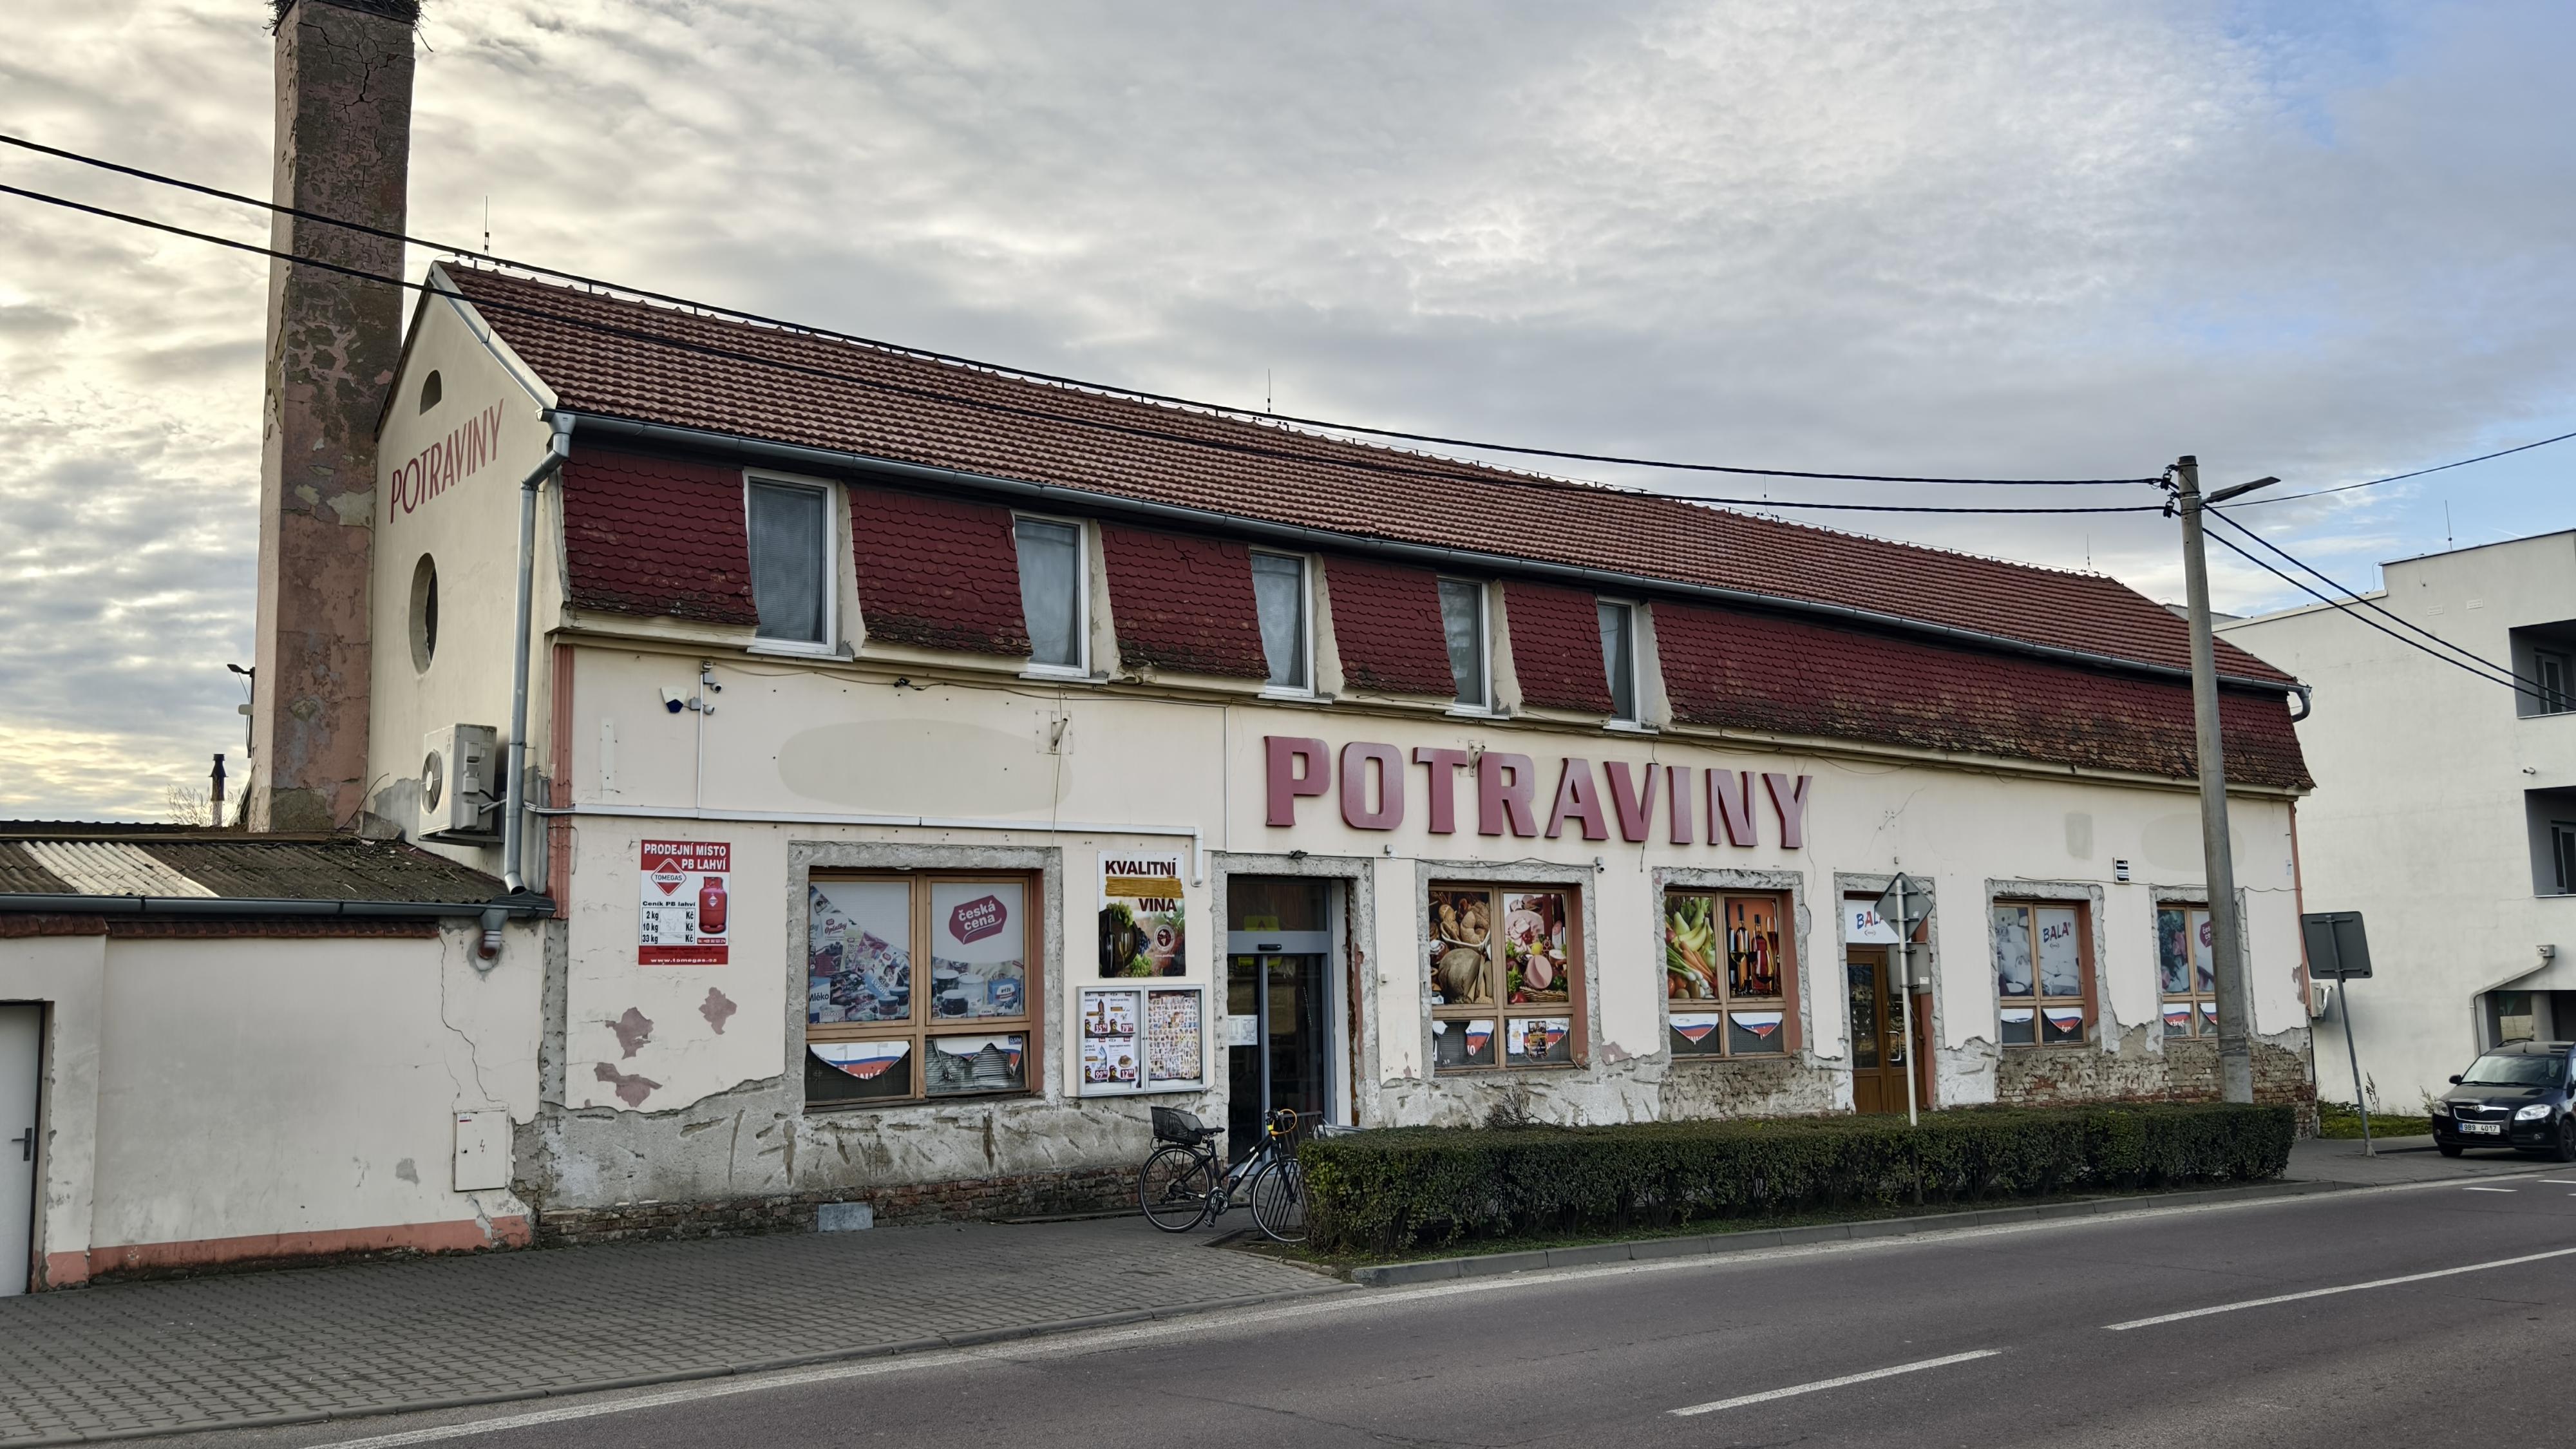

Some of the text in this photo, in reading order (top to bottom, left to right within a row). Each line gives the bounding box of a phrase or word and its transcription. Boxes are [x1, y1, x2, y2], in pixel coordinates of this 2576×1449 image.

[390, 398, 504, 525] POTRAVINY
[1264, 735, 1813, 849] POTRAVINY
[644, 843, 726, 856] PRODEJNÍ MÍSTO
[682, 857, 726, 870] PB LAHVÍ
[1105, 858, 1177, 875] KVALITNÍ
[646, 911, 694, 921] 2 kg Kč
[958, 900, 996, 921] česká
[643, 922, 694, 933] 10 kg Kč
[964, 914, 996, 931] cena
[642, 934, 650, 943] 33
[650, 934, 658, 944] kg
[685, 934, 693, 943] Kč
